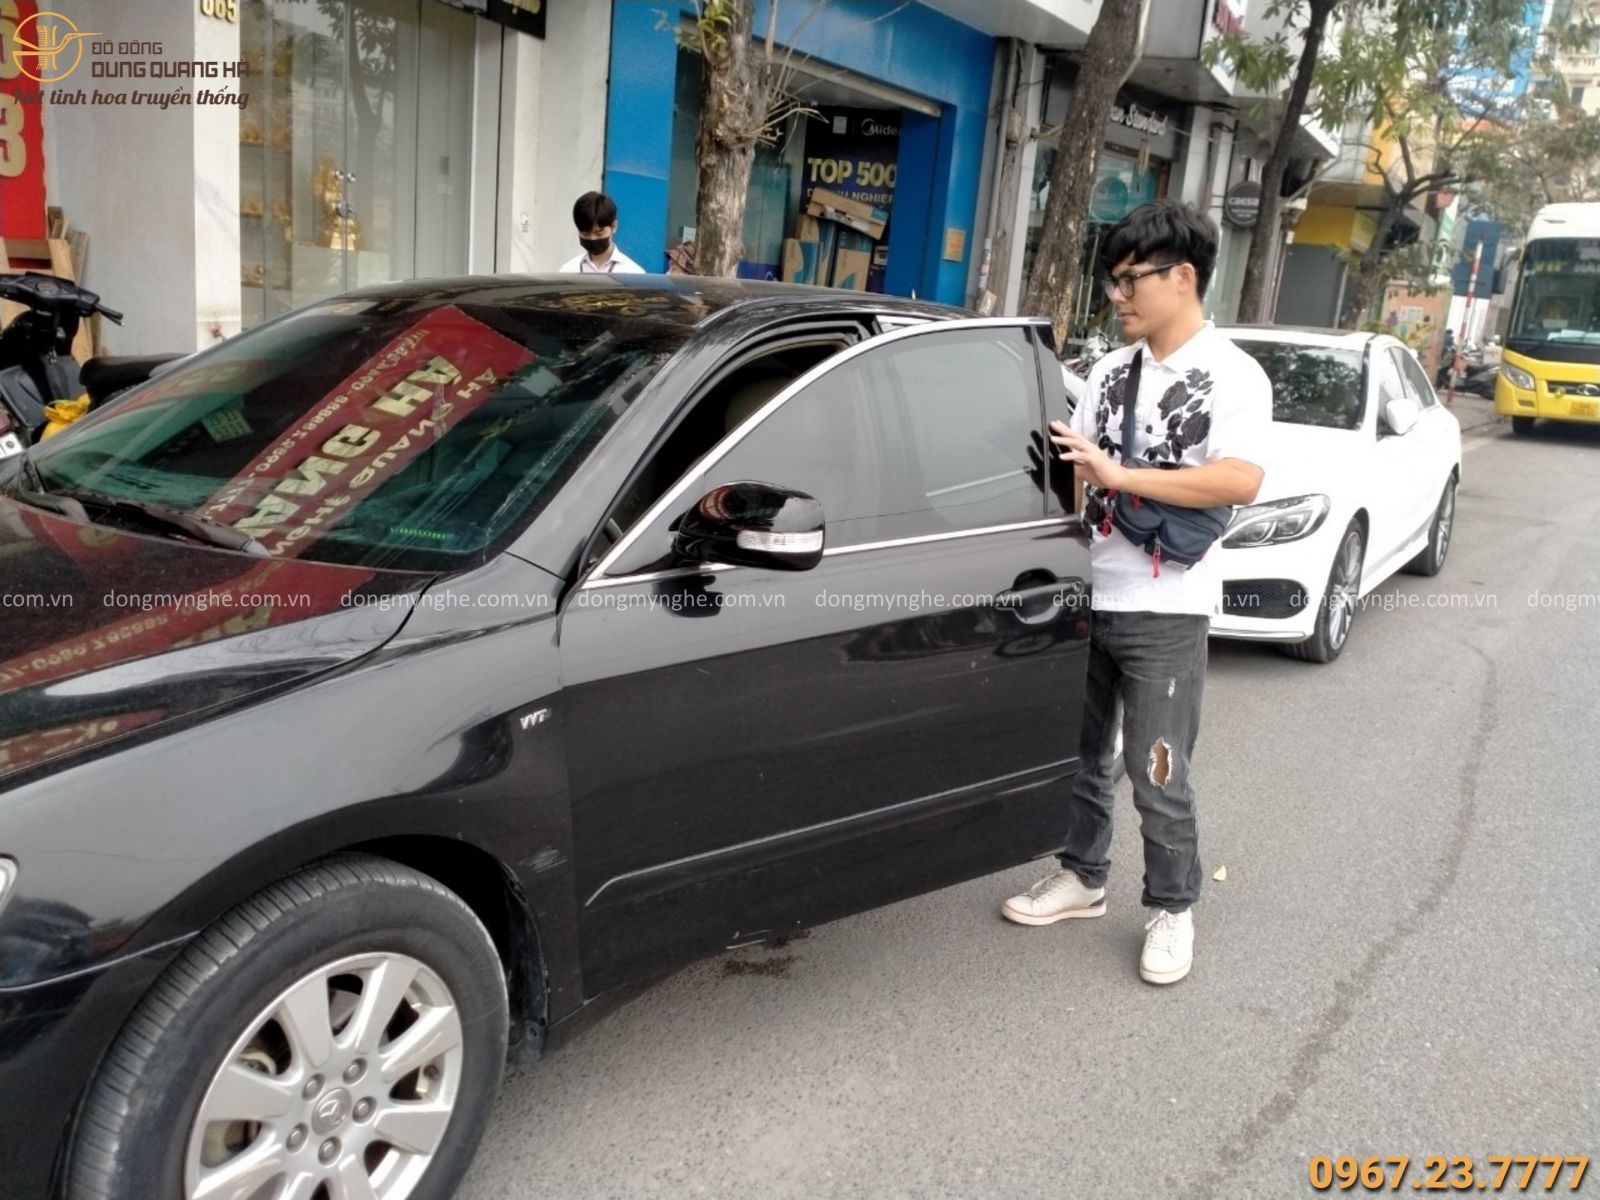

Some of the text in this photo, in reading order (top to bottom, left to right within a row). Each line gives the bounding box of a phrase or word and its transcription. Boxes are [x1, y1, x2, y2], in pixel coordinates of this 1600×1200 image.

[861, 118, 900, 136] Mide
[807, 157, 897, 188] TOP 500
